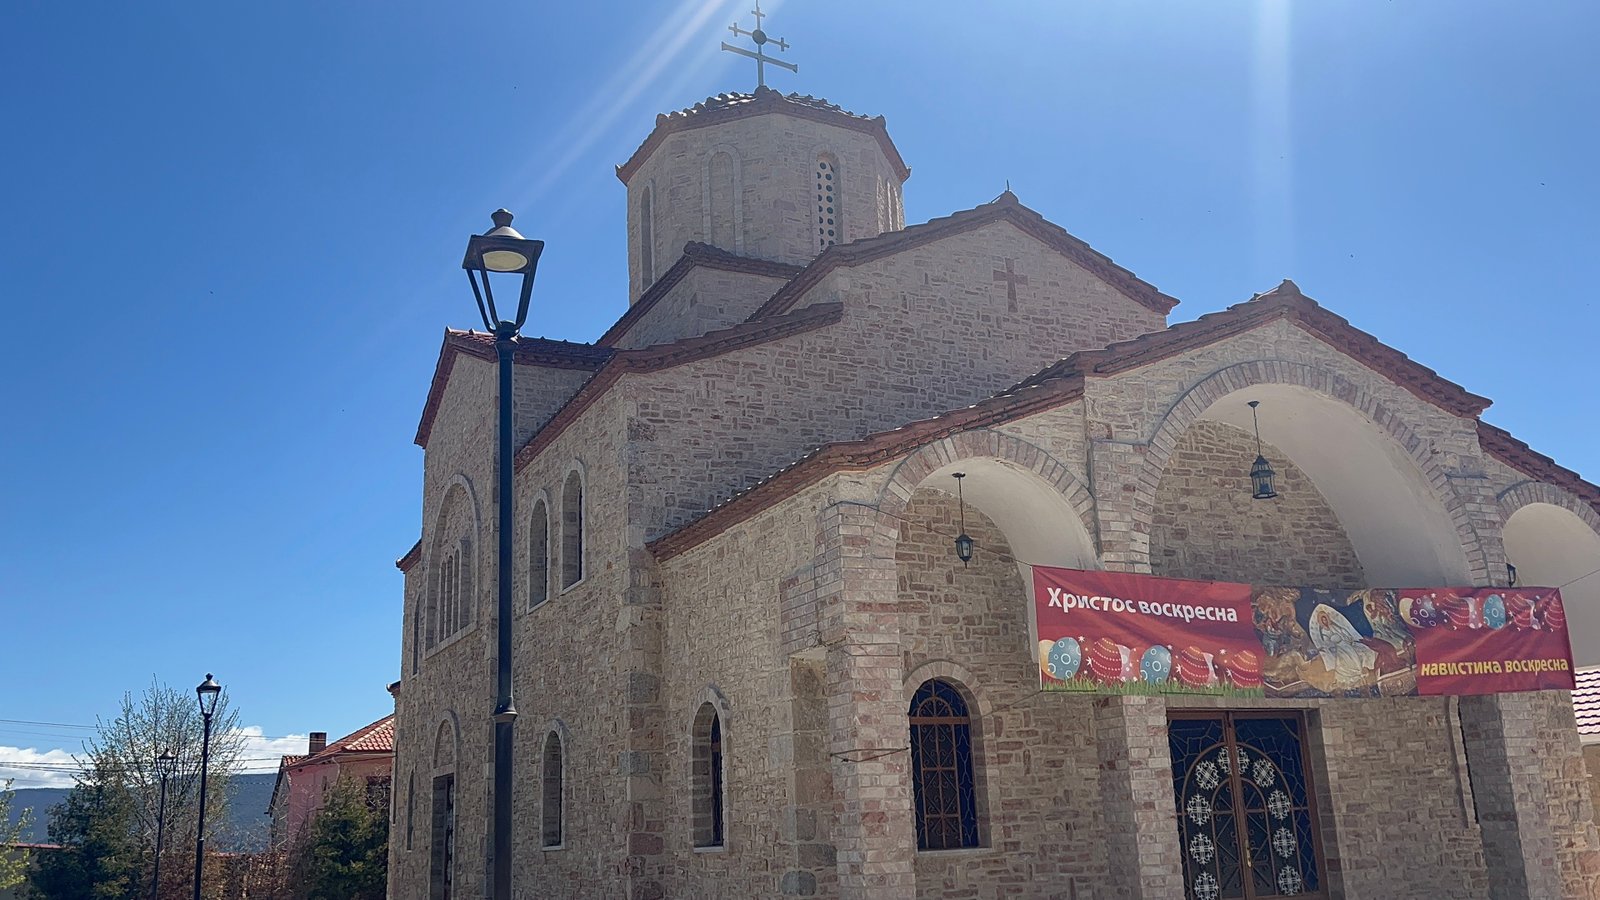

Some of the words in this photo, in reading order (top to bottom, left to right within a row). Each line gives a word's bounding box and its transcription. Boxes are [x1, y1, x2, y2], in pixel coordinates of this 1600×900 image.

[1047, 587, 1136, 613] Христос
[1138, 601, 1238, 623] воскресна
[1421, 660, 1502, 676] навистина
[1504, 658, 1569, 676] воскресна
